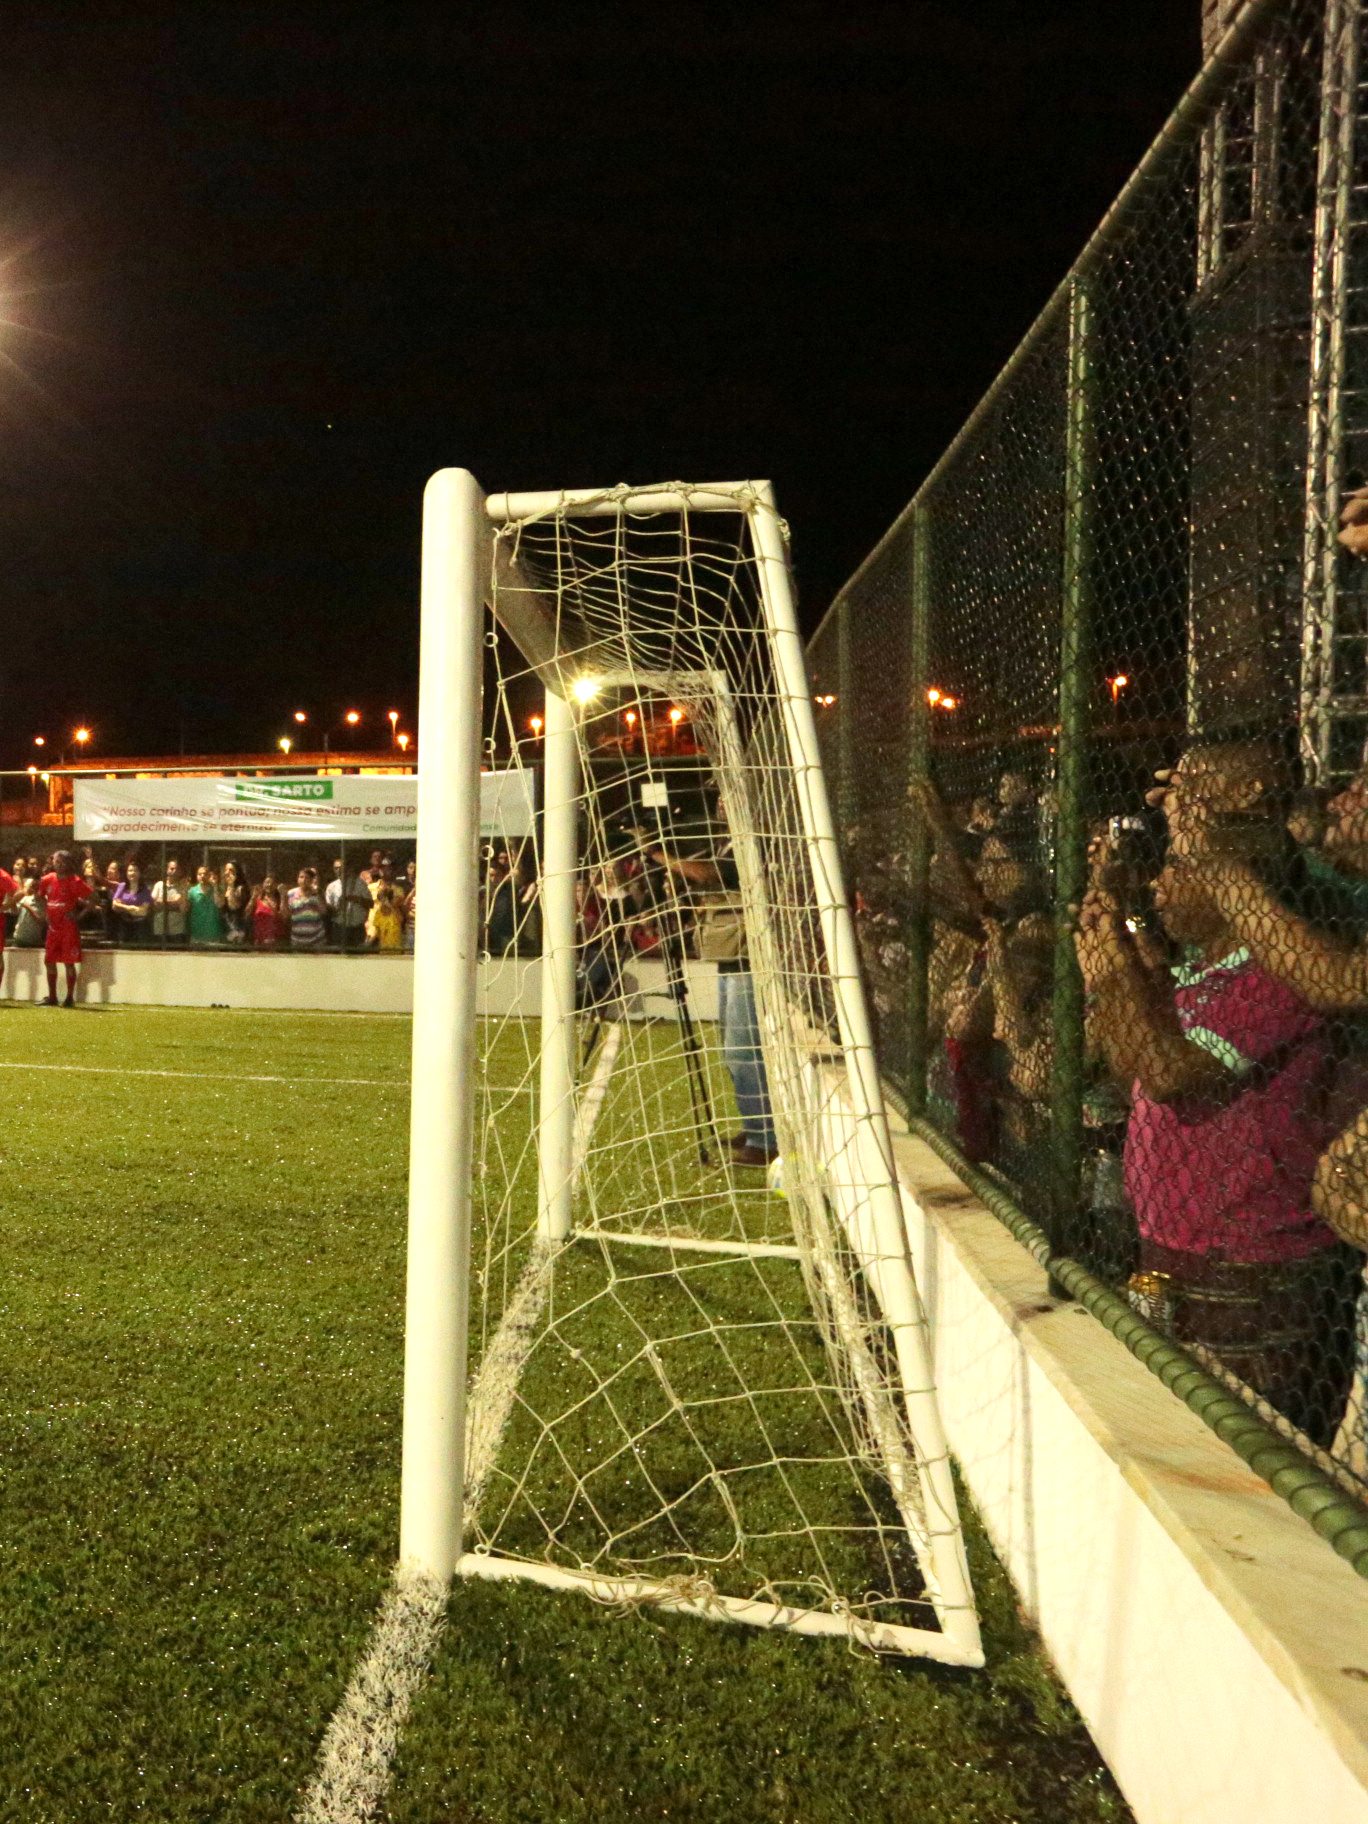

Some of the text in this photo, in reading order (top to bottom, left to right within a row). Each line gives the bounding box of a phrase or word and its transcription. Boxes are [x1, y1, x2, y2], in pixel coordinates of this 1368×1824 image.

[273, 784, 325, 797] SARTO
[149, 806, 197, 817] carinho
[200, 809, 215, 817] se
[316, 804, 361, 816] estima
[365, 806, 381, 816] se
[384, 805, 417, 818] amp
[103, 821, 199, 833] agradecimento
[362, 823, 417, 832] Comunidad
